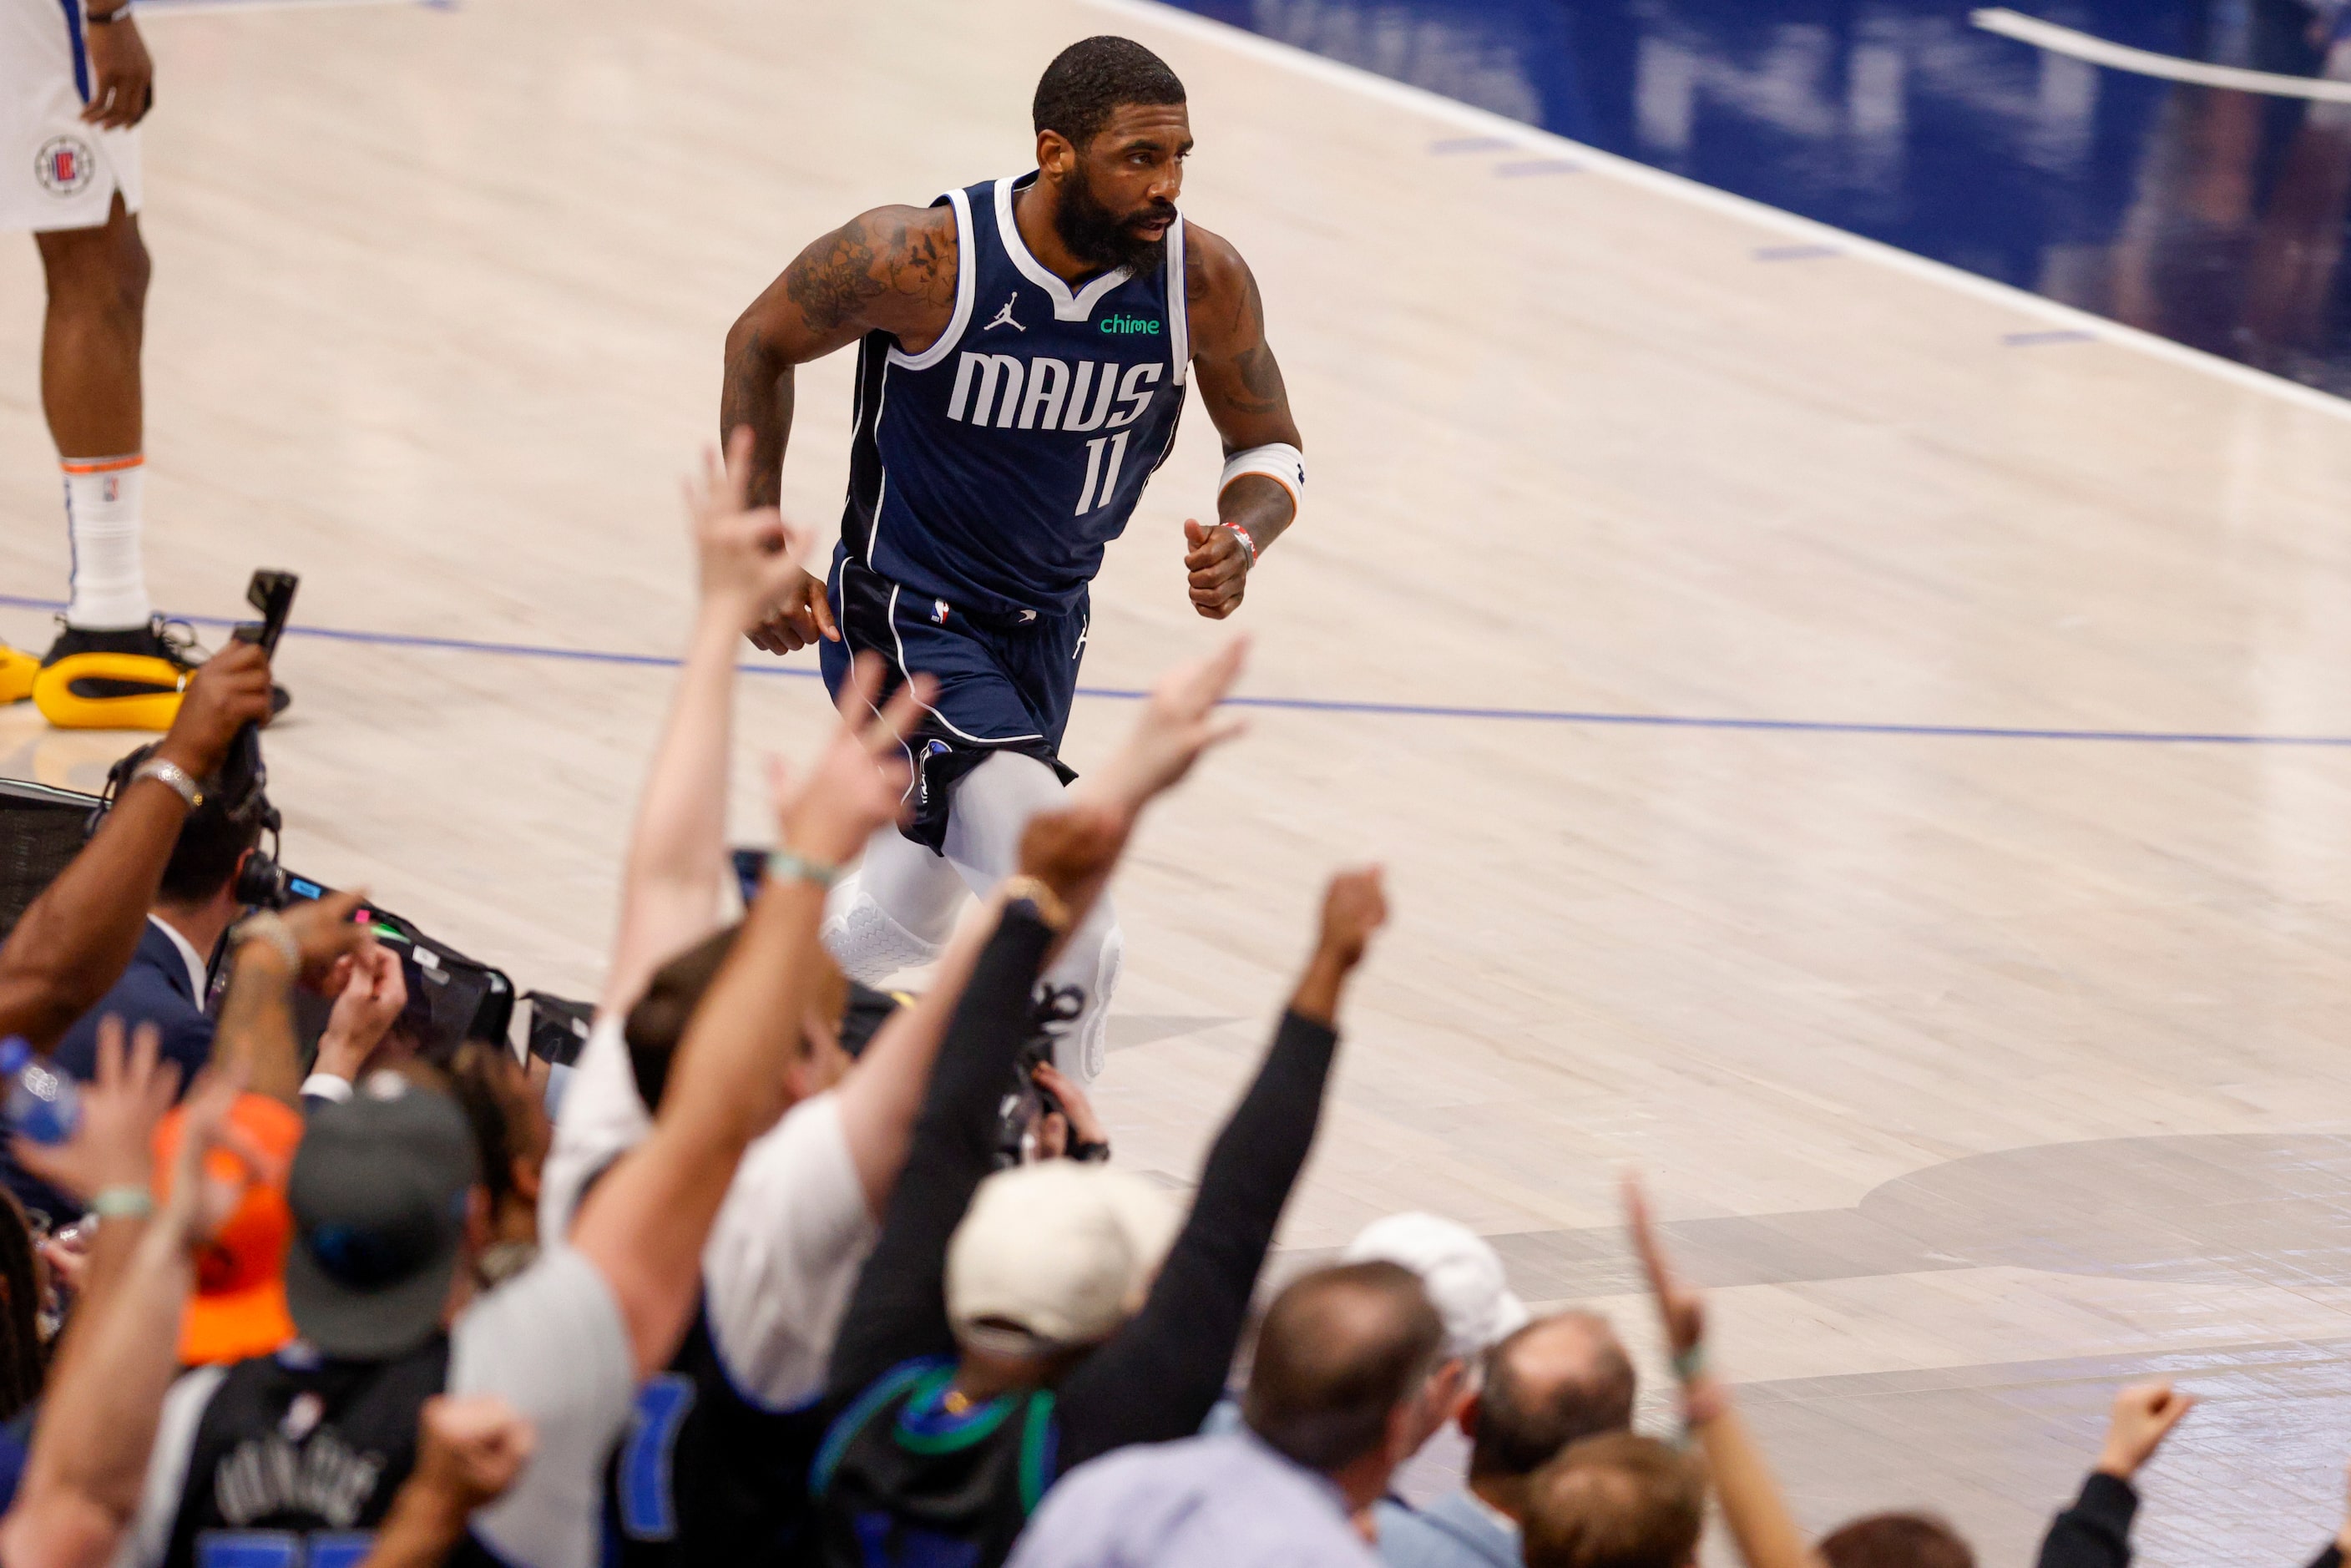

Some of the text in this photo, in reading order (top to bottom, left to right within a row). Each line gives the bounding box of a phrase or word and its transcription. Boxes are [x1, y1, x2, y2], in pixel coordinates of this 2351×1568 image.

[1100, 314, 1160, 334] chime
[947, 351, 1164, 432] MAVS
[1074, 429, 1131, 517] 11
